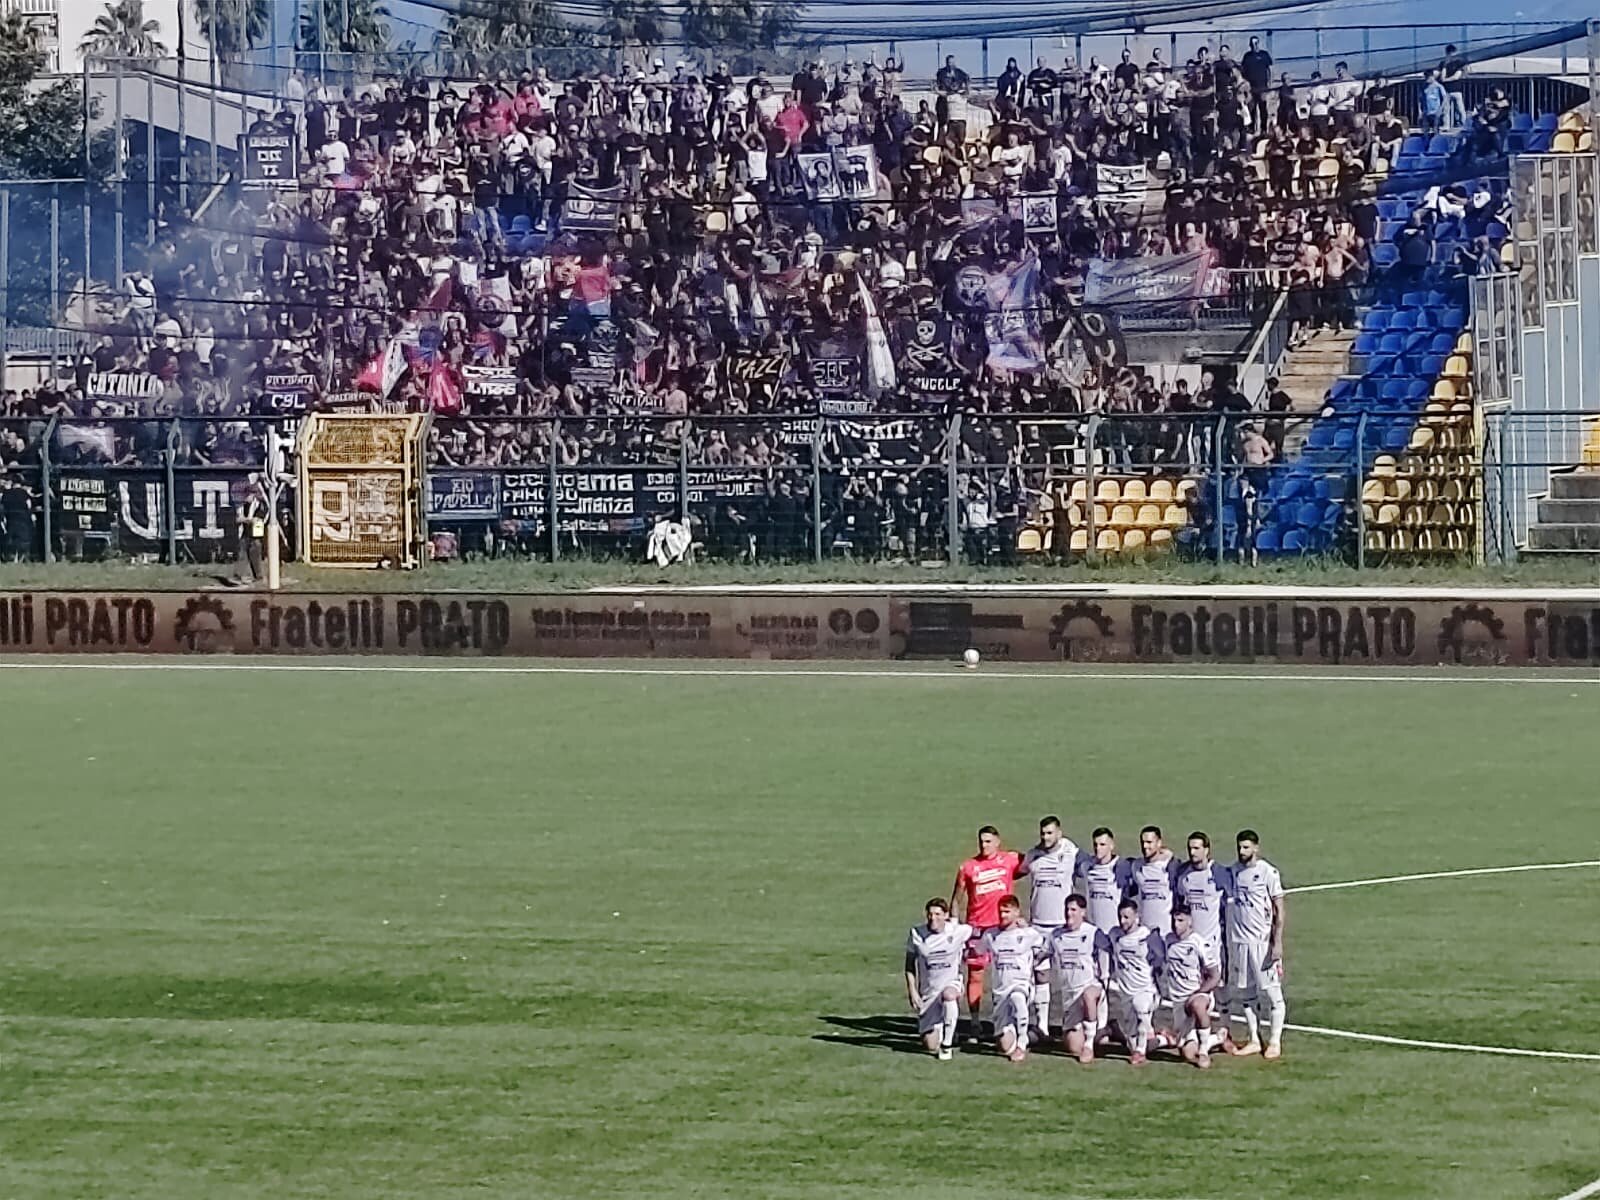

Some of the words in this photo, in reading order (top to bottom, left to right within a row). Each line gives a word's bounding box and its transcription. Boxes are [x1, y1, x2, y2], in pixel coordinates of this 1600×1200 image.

[87, 373, 160, 397] CATANIA
[46, 597, 155, 646] PRATO
[251, 596, 384, 648] Fratelli
[397, 599, 510, 649] PRATO
[1131, 602, 1278, 656] Fratelli
[1294, 606, 1416, 657] PRATO
